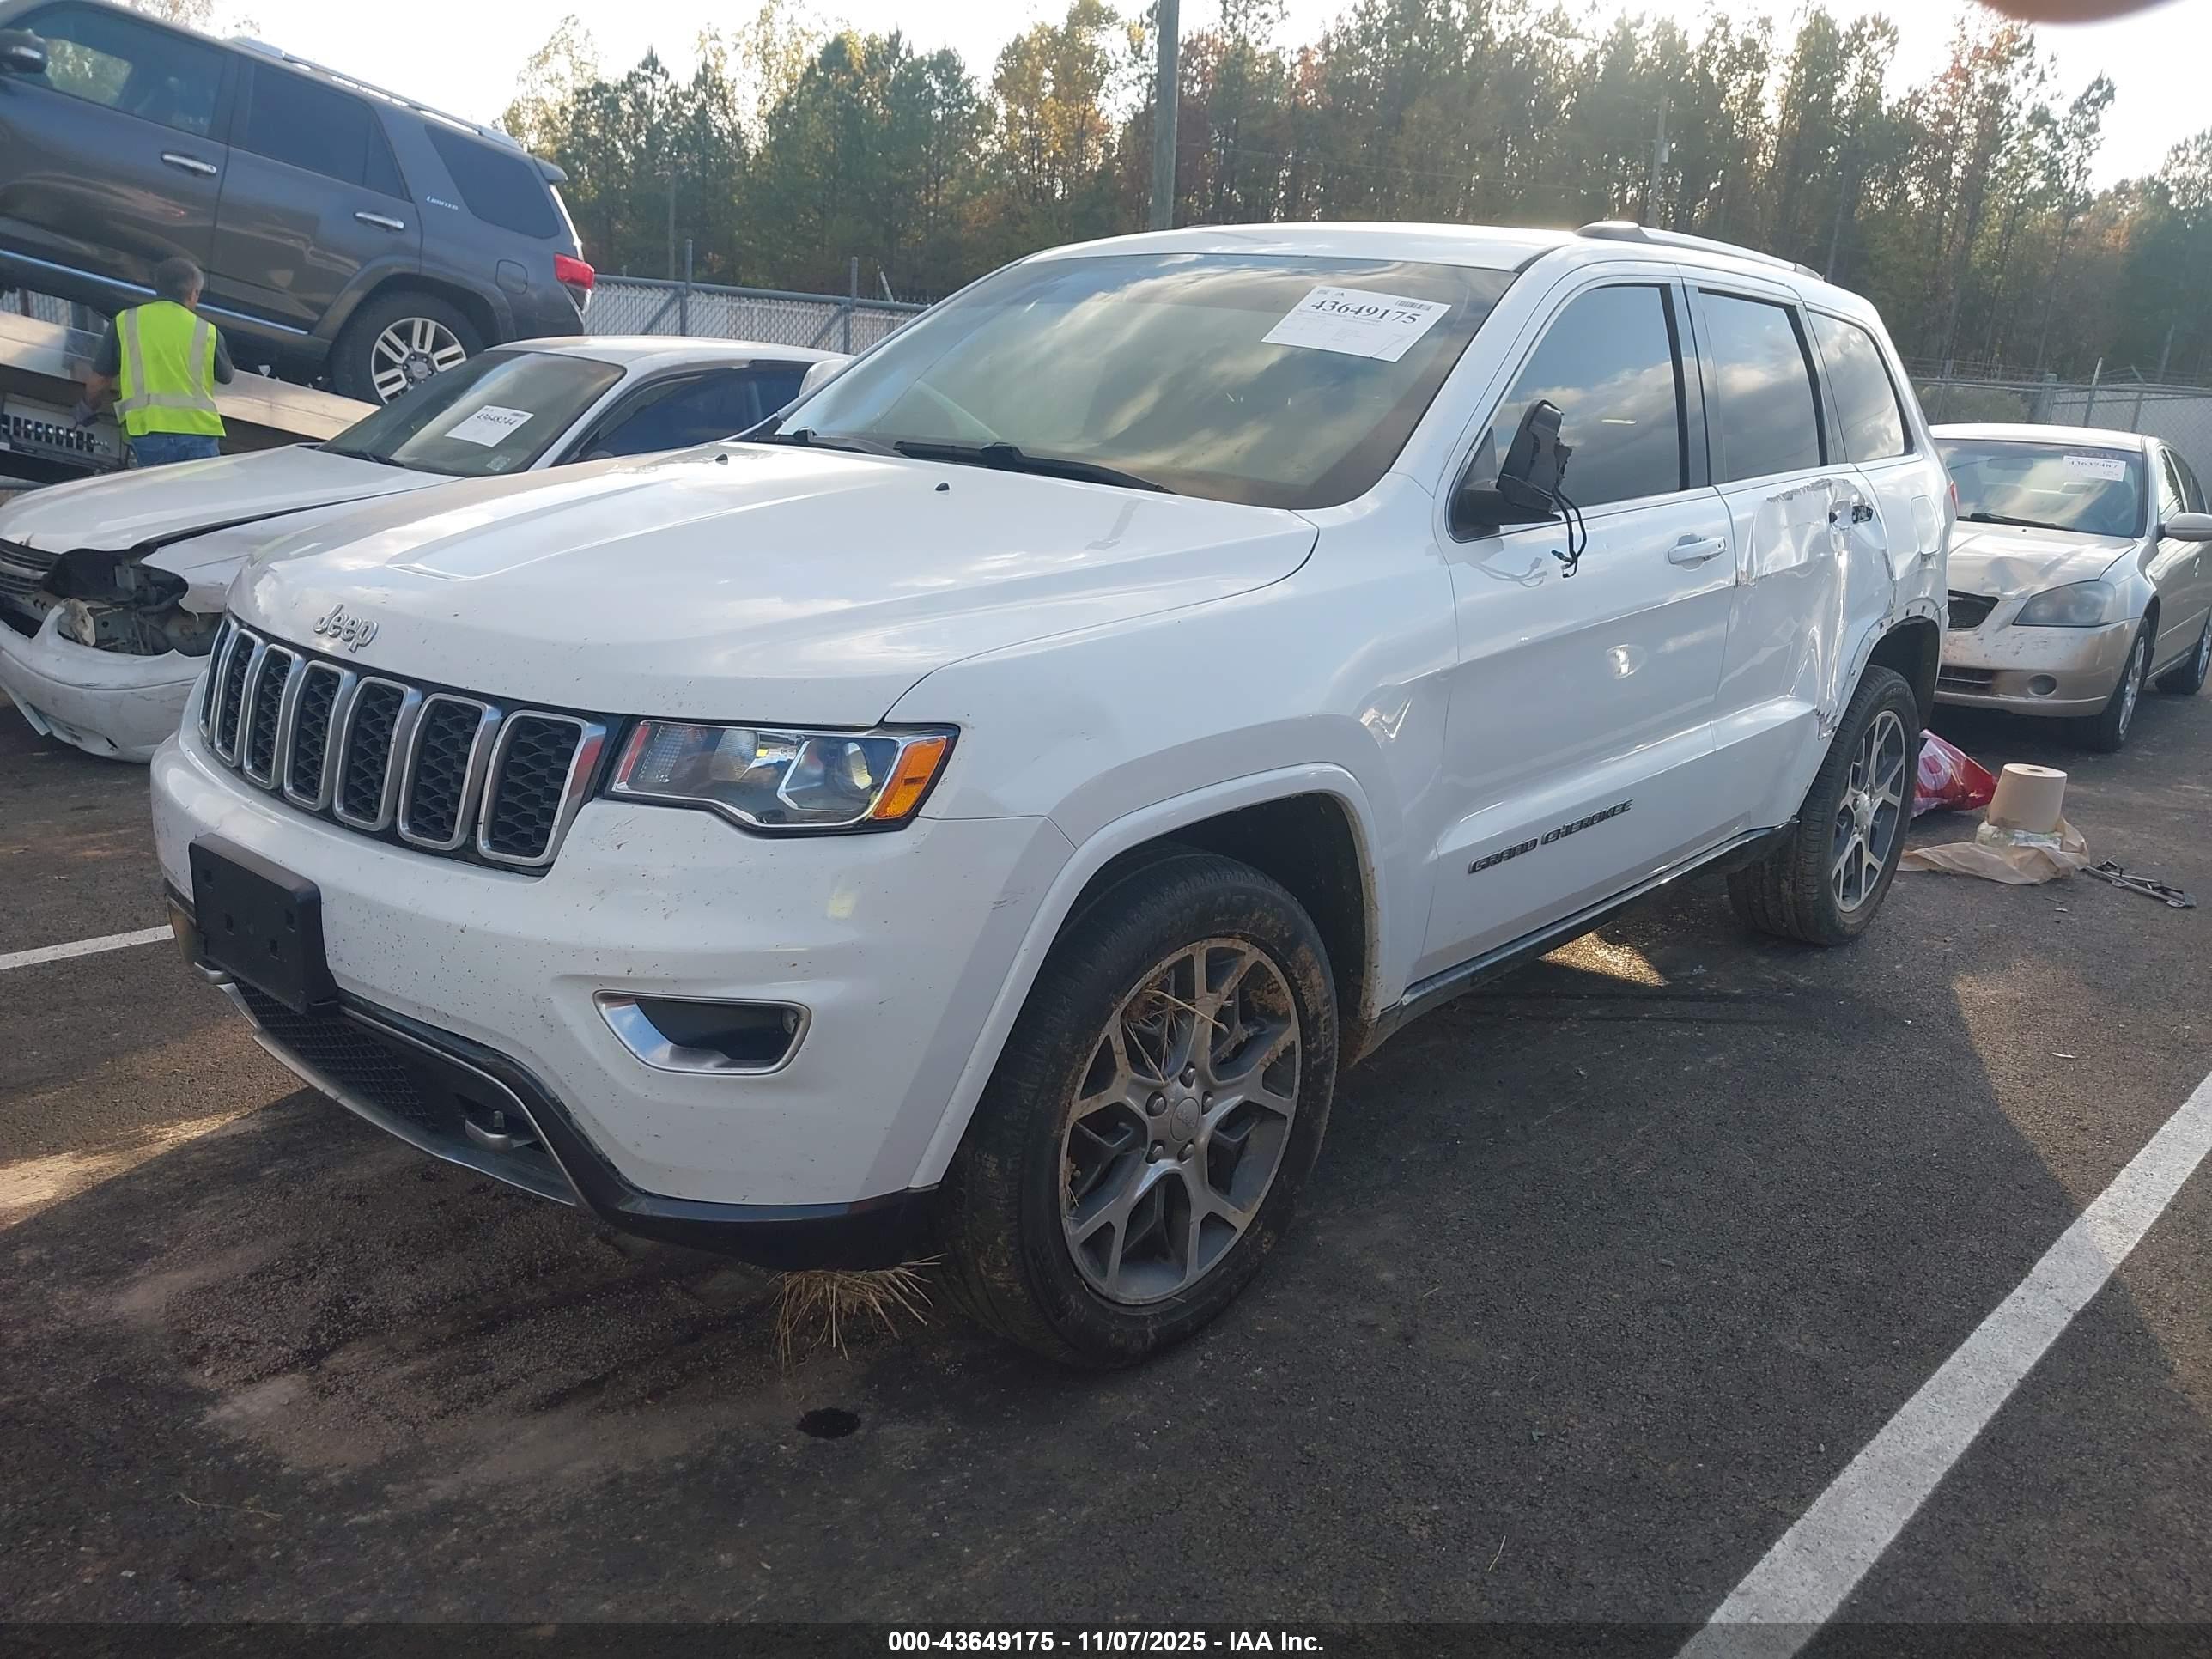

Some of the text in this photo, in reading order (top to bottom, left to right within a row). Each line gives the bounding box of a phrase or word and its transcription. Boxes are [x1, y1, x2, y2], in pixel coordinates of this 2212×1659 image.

[1311, 299, 1421, 325] 43649175
[313, 603, 379, 653] Jeep
[1468, 797, 1634, 875] GRAND CHEROKEE
